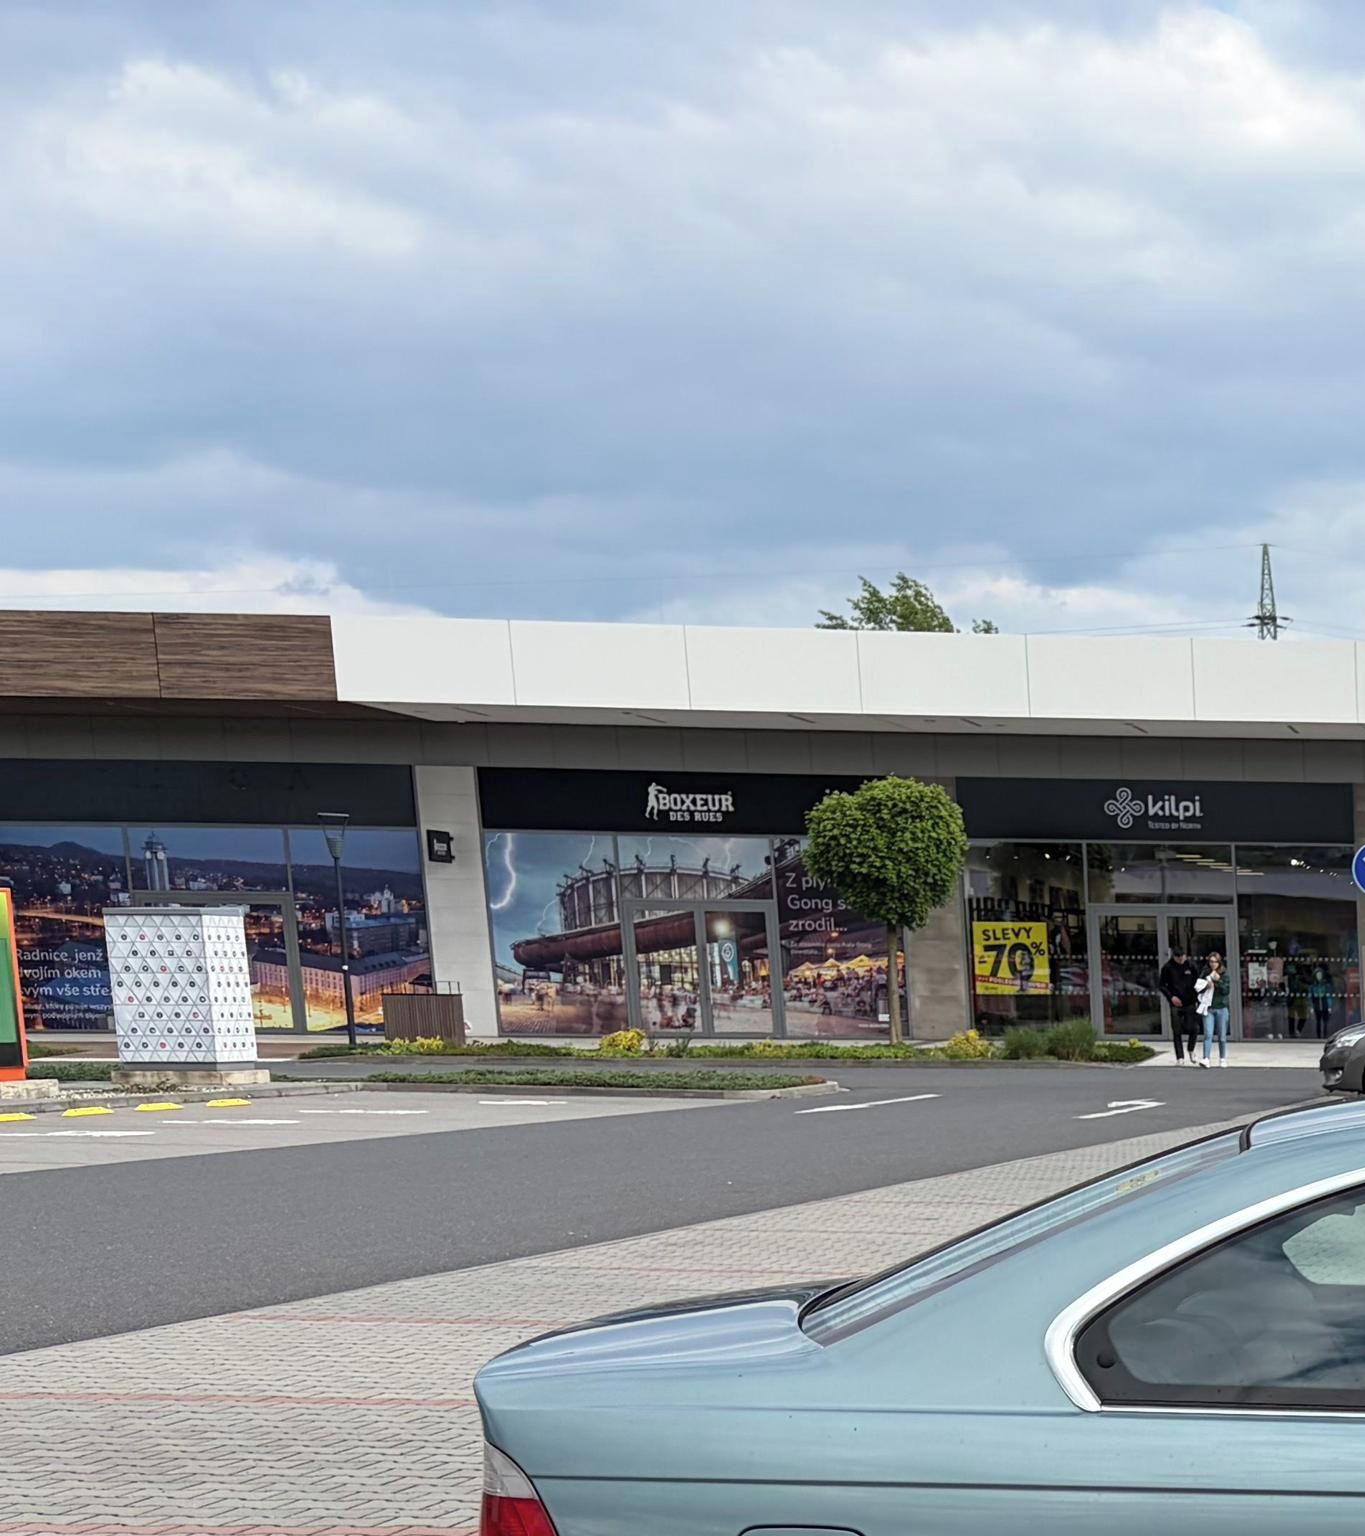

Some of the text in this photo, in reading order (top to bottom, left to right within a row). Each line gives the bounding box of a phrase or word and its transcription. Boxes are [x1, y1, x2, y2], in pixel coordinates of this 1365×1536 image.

[658, 793, 735, 811] BOXEUR
[1147, 794, 1203, 820] kilpi
[669, 811, 723, 822] DES RUES
[785, 872, 797, 888] Z
[787, 894, 833, 913] Gong
[789, 917, 848, 932] zrodil...
[982, 926, 1033, 941] SLEVY
[75, 948, 104, 963] jenž
[64, 967, 102, 978] okem
[21, 983, 53, 998] vým
[56, 983, 80, 996] vše
